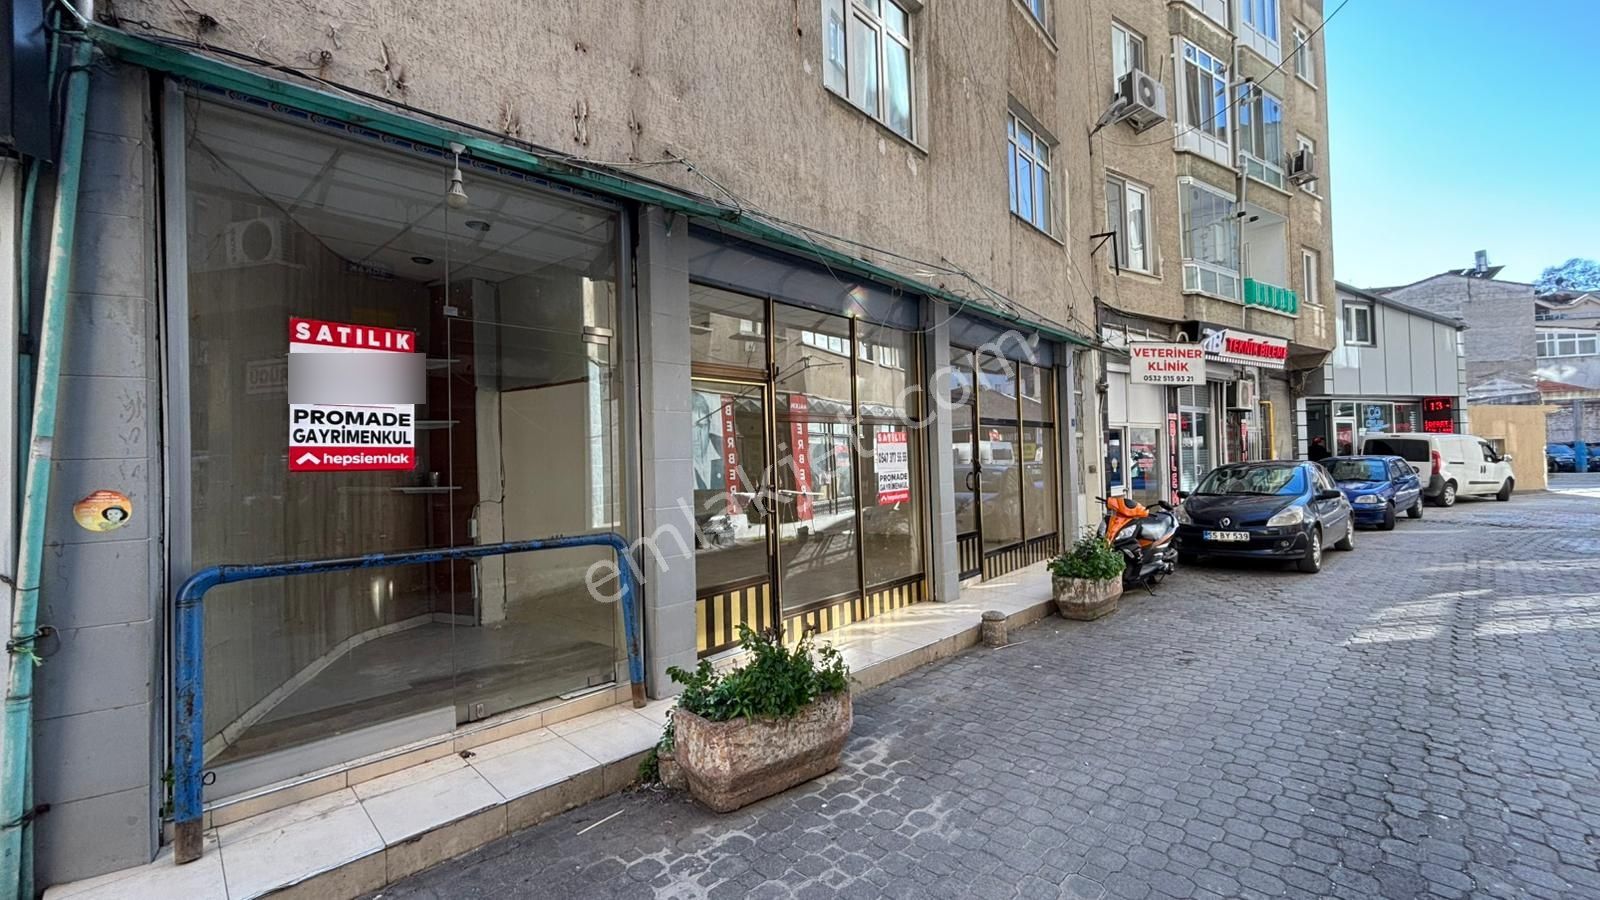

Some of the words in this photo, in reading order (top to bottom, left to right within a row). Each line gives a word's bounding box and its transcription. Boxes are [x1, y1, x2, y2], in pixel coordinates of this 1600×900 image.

[295, 322, 410, 350] SATILIK
[1133, 347, 1202, 358] VETERİNER
[1148, 360, 1189, 371] KLİNİK
[293, 409, 411, 427] PROMADE
[293, 425, 411, 444] GAYRİMENKUL
[877, 433, 907, 442] SATILIK
[323, 452, 409, 466] hepsiemlak
[880, 472, 908, 482] PROMADE
